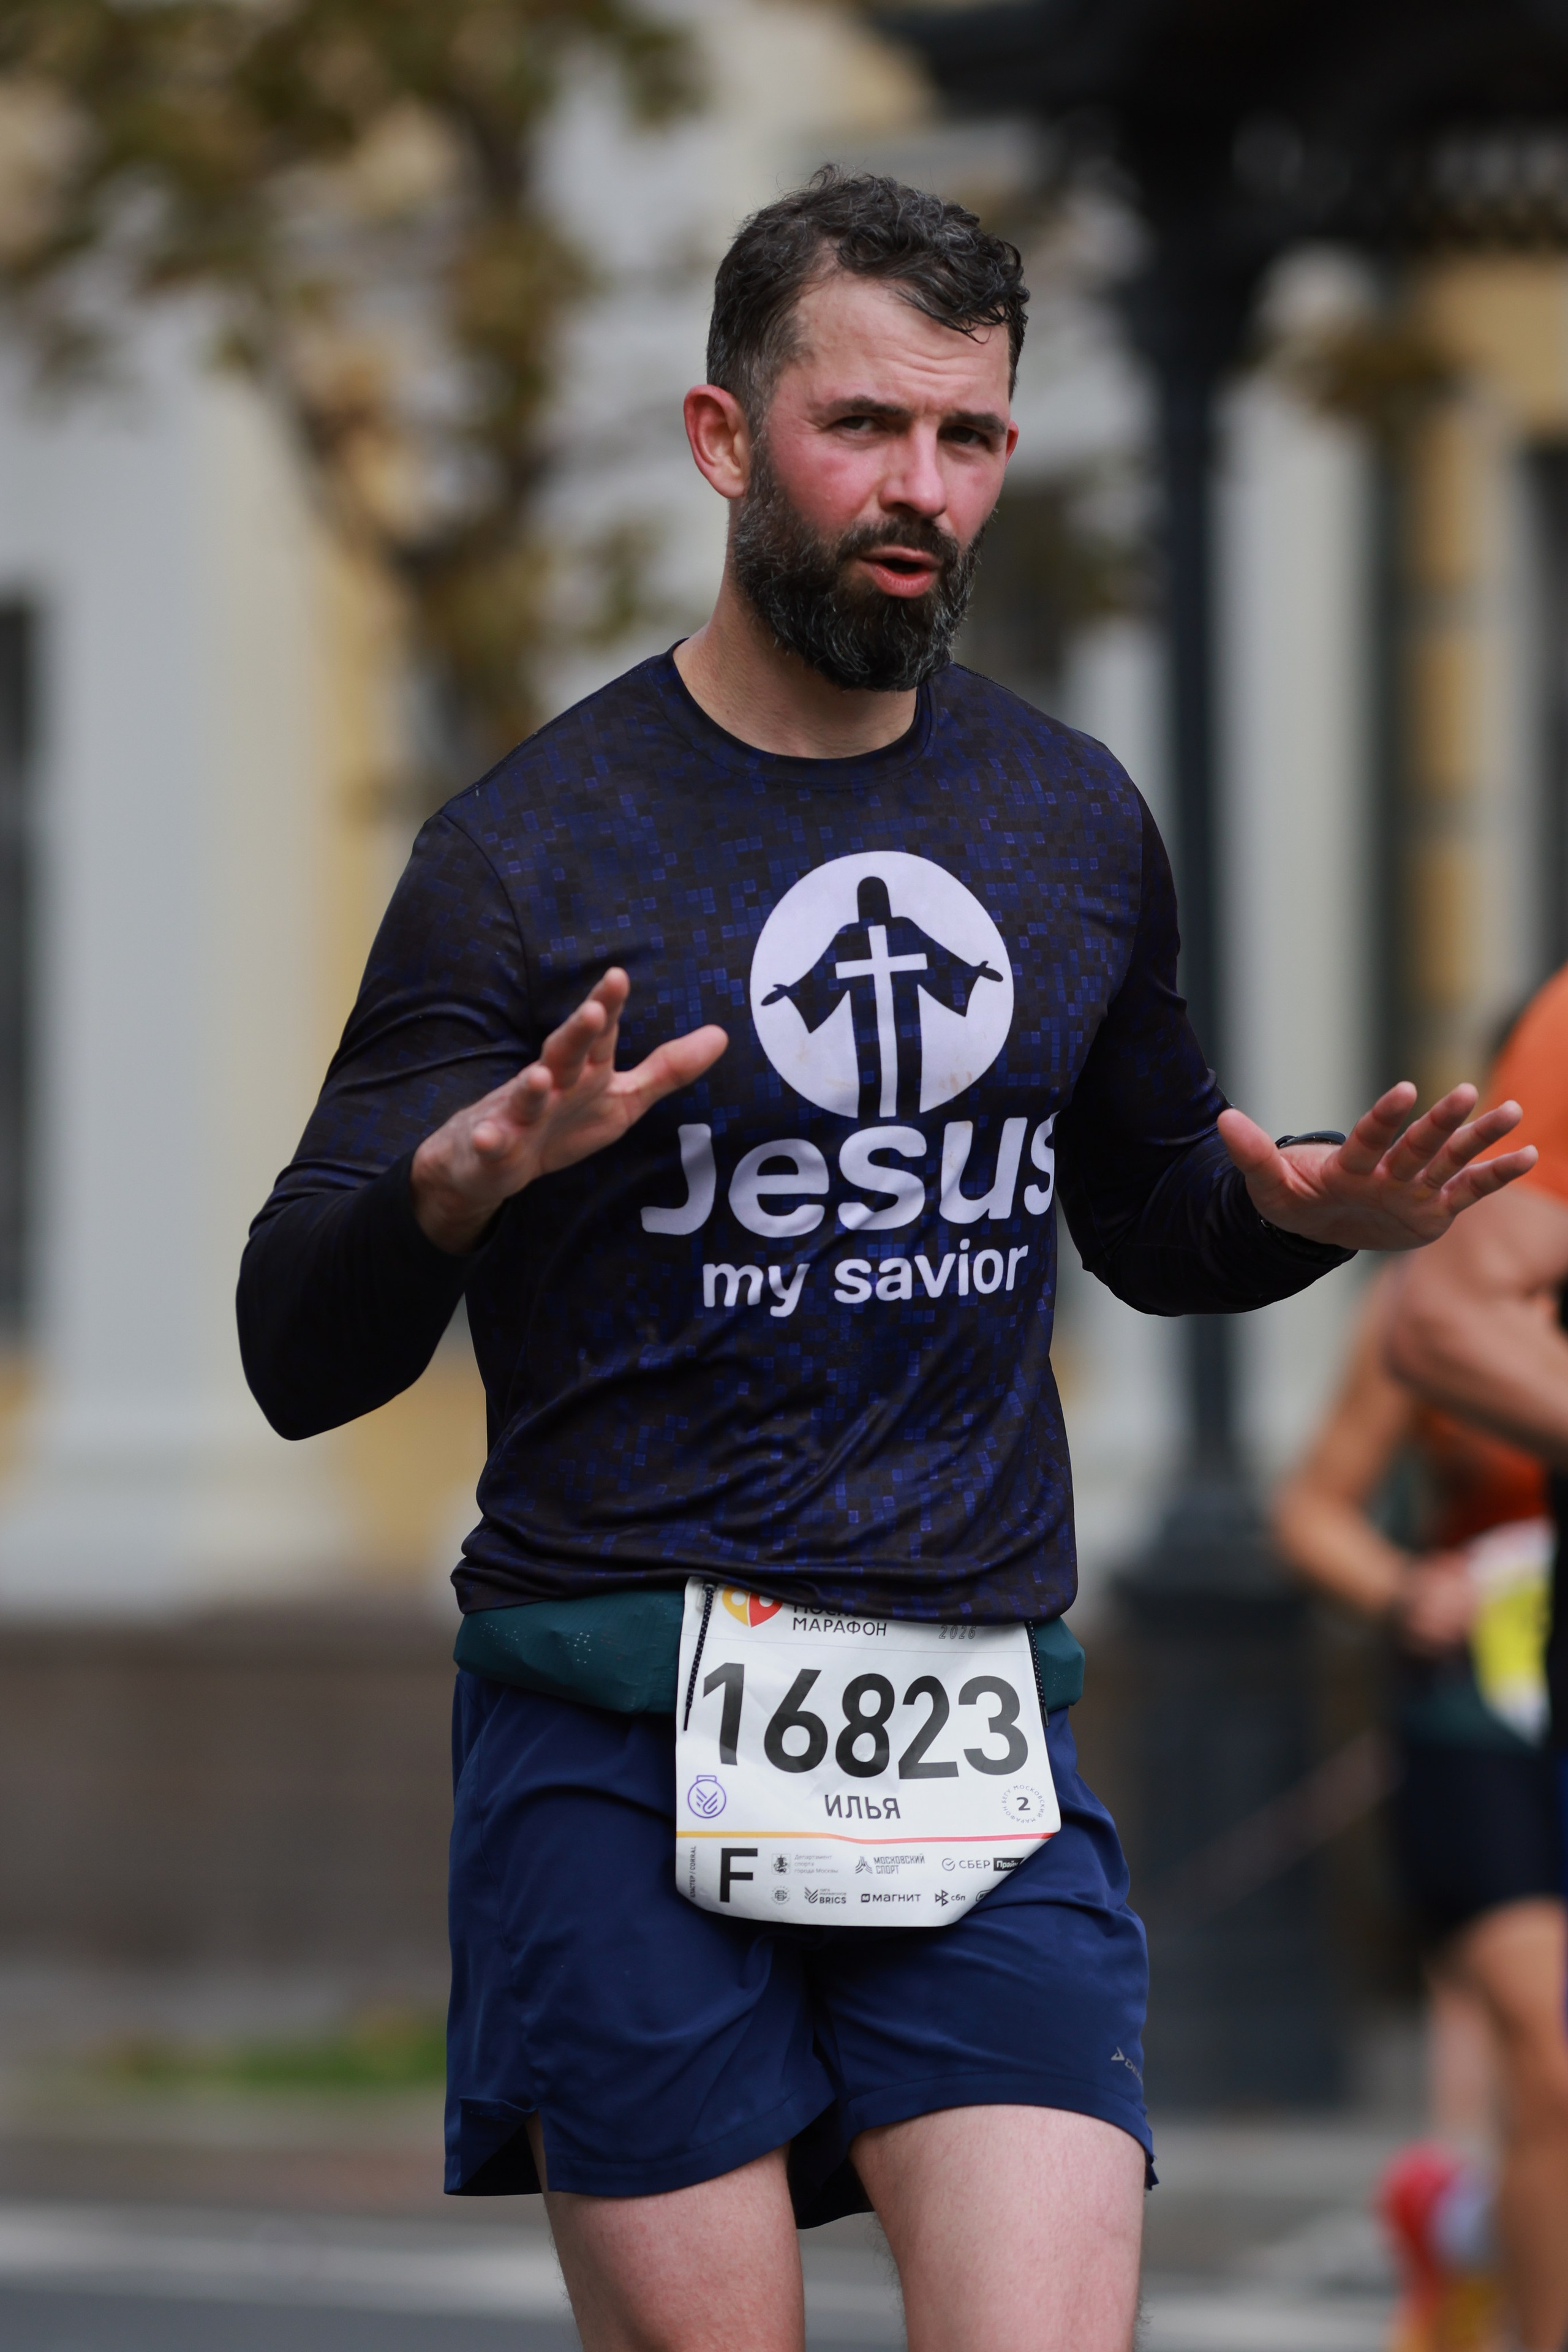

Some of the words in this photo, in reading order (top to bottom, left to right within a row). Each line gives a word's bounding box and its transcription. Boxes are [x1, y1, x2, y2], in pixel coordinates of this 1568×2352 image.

[641, 1110, 1061, 1238] Jesus
[703, 1264, 810, 1317] my
[834, 1238, 1028, 1303] savior
[793, 1618, 887, 1636] МАРАФОН
[938, 1624, 976, 1640] 2026
[703, 1662, 1028, 1780] 16823
[824, 1794, 901, 1820] ИЛЬЯ
[1016, 1796, 1031, 1811] 2
[873, 1853, 925, 1864] МОСКОВСКИЙ
[959, 1860, 990, 1869] СБЕР
[719, 1847, 758, 1903] F
[875, 1865, 899, 1874] СПОРТ
[872, 1893, 921, 1902] магнит
